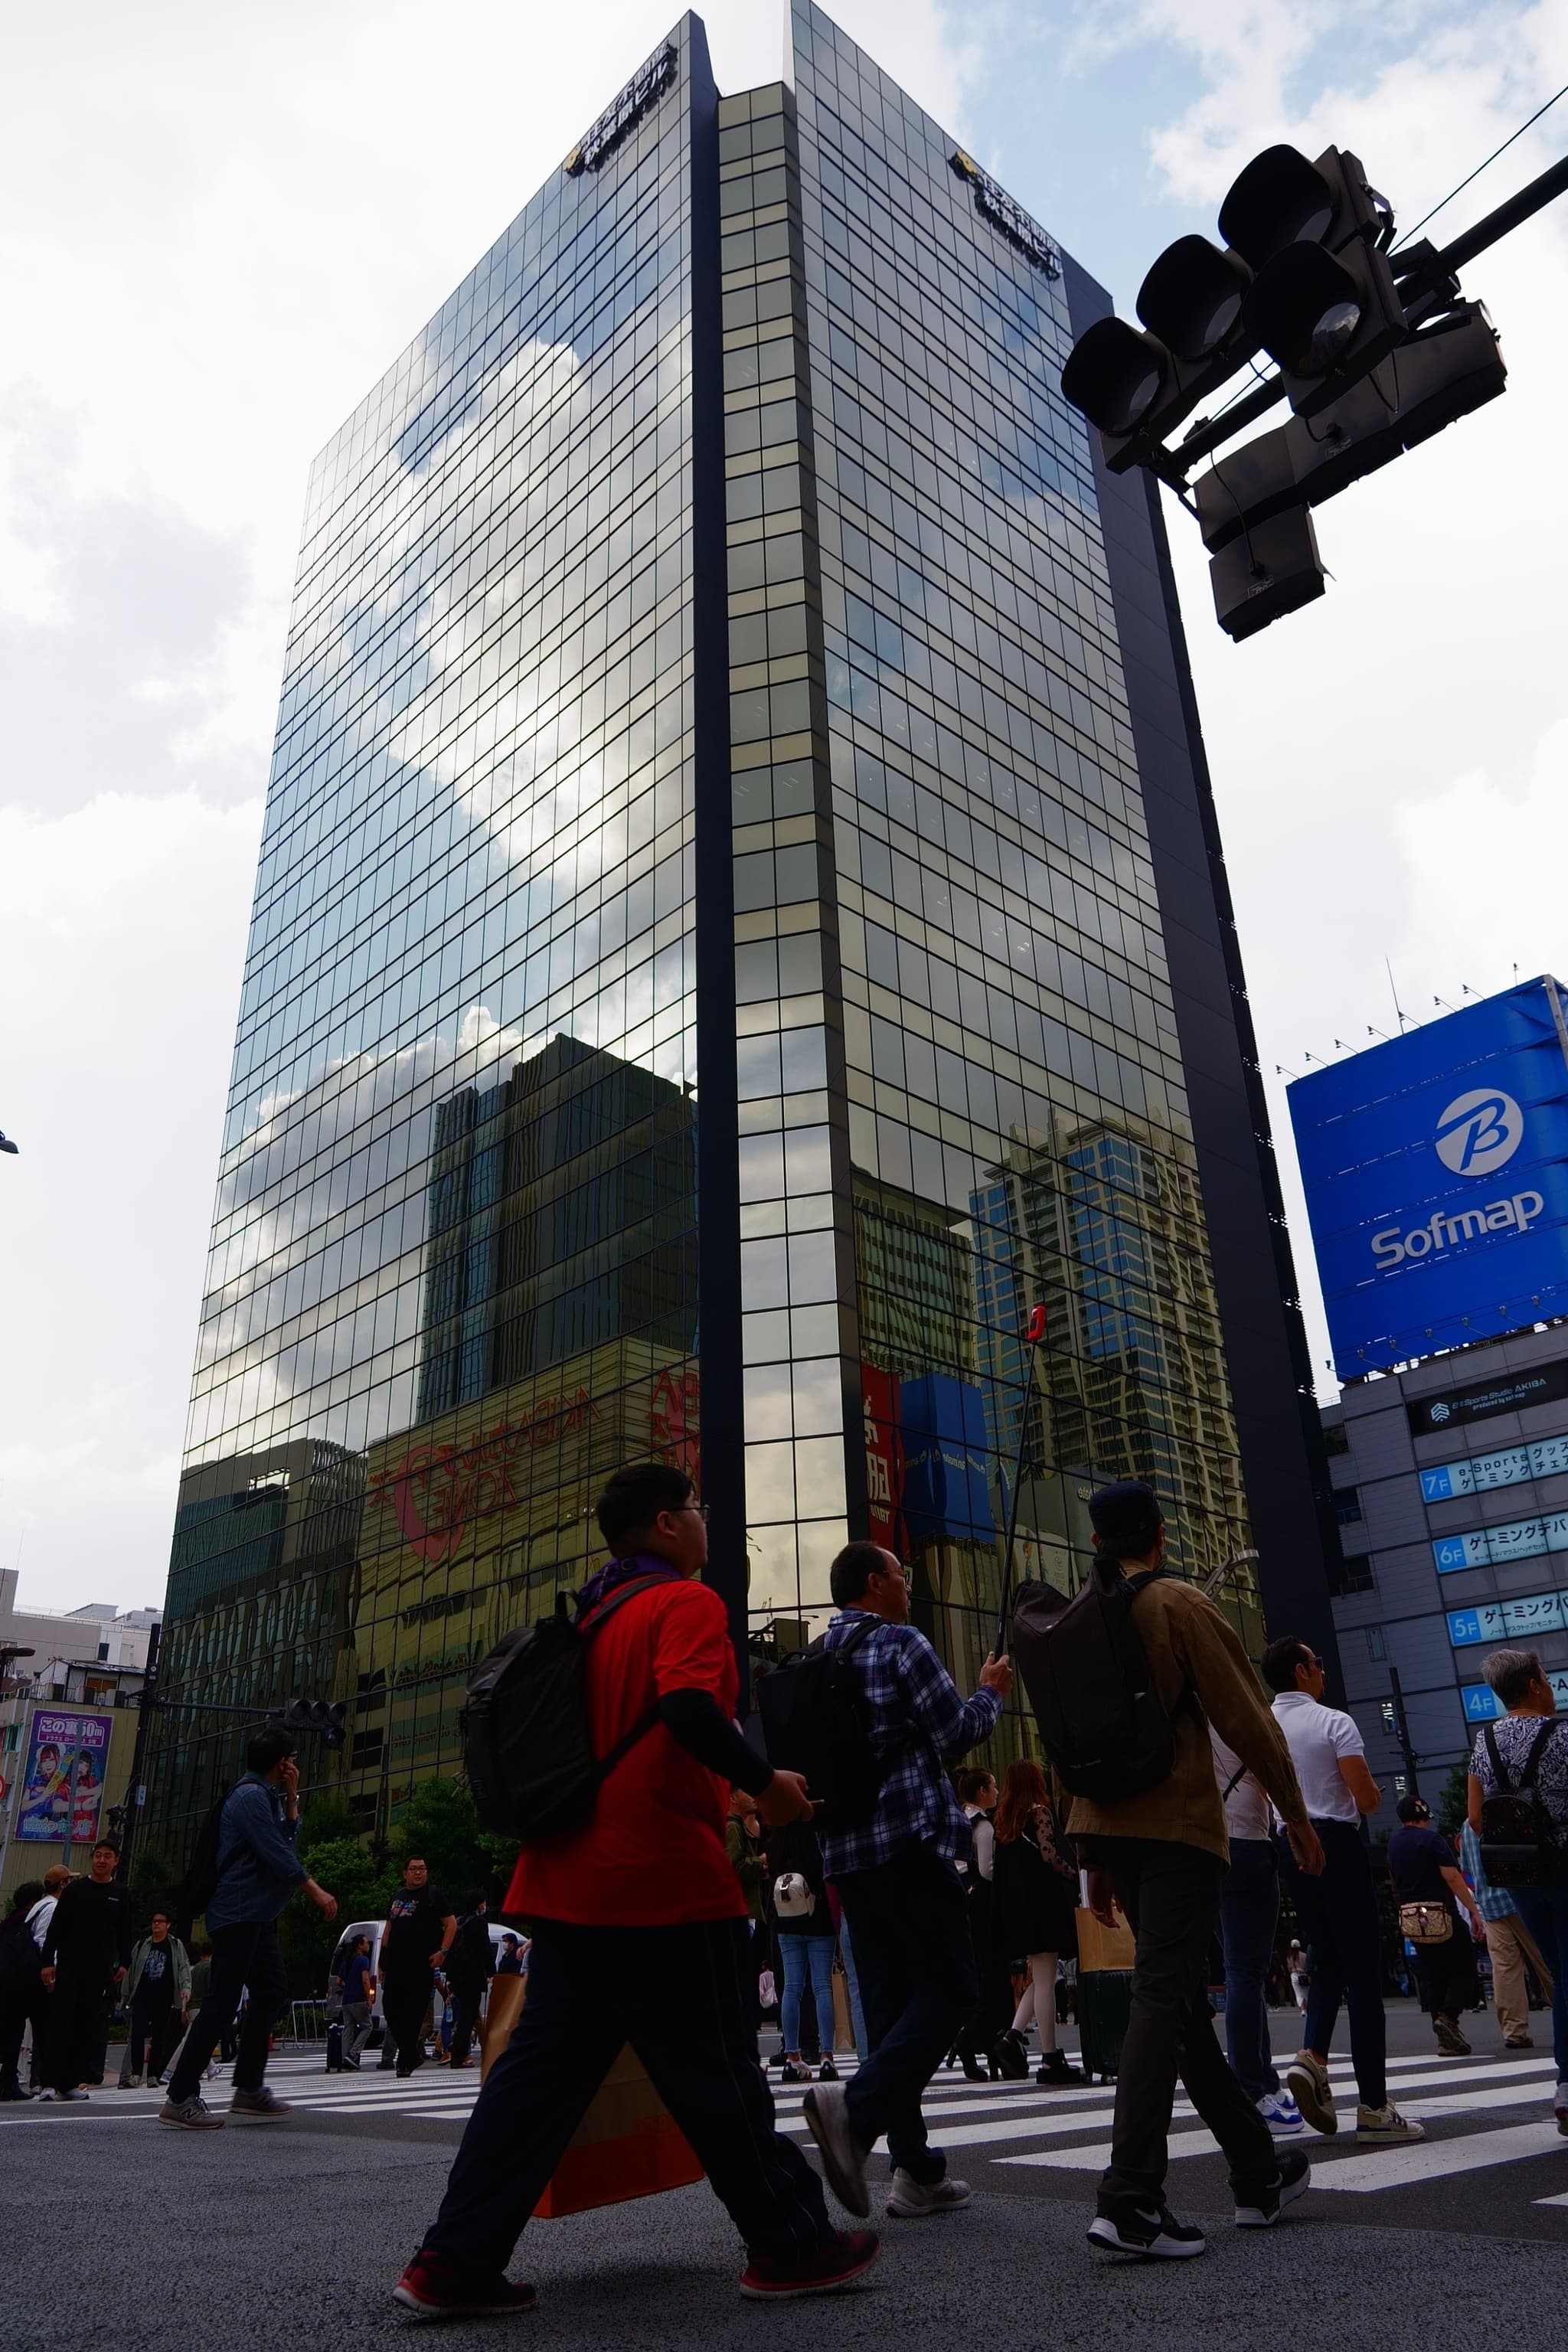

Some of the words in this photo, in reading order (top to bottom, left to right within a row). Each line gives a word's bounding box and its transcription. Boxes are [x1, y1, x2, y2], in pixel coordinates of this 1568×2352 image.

[1371, 1191, 1544, 1269] Sofmap
[1489, 1388, 1513, 1400] Studio
[1514, 1378, 1547, 1393] AKIBA
[1425, 1475, 1448, 1494] 7F
[1439, 1546, 1462, 1564] 6F
[1455, 1619, 1477, 1637] 5F
[1469, 1693, 1493, 1713] 4F
